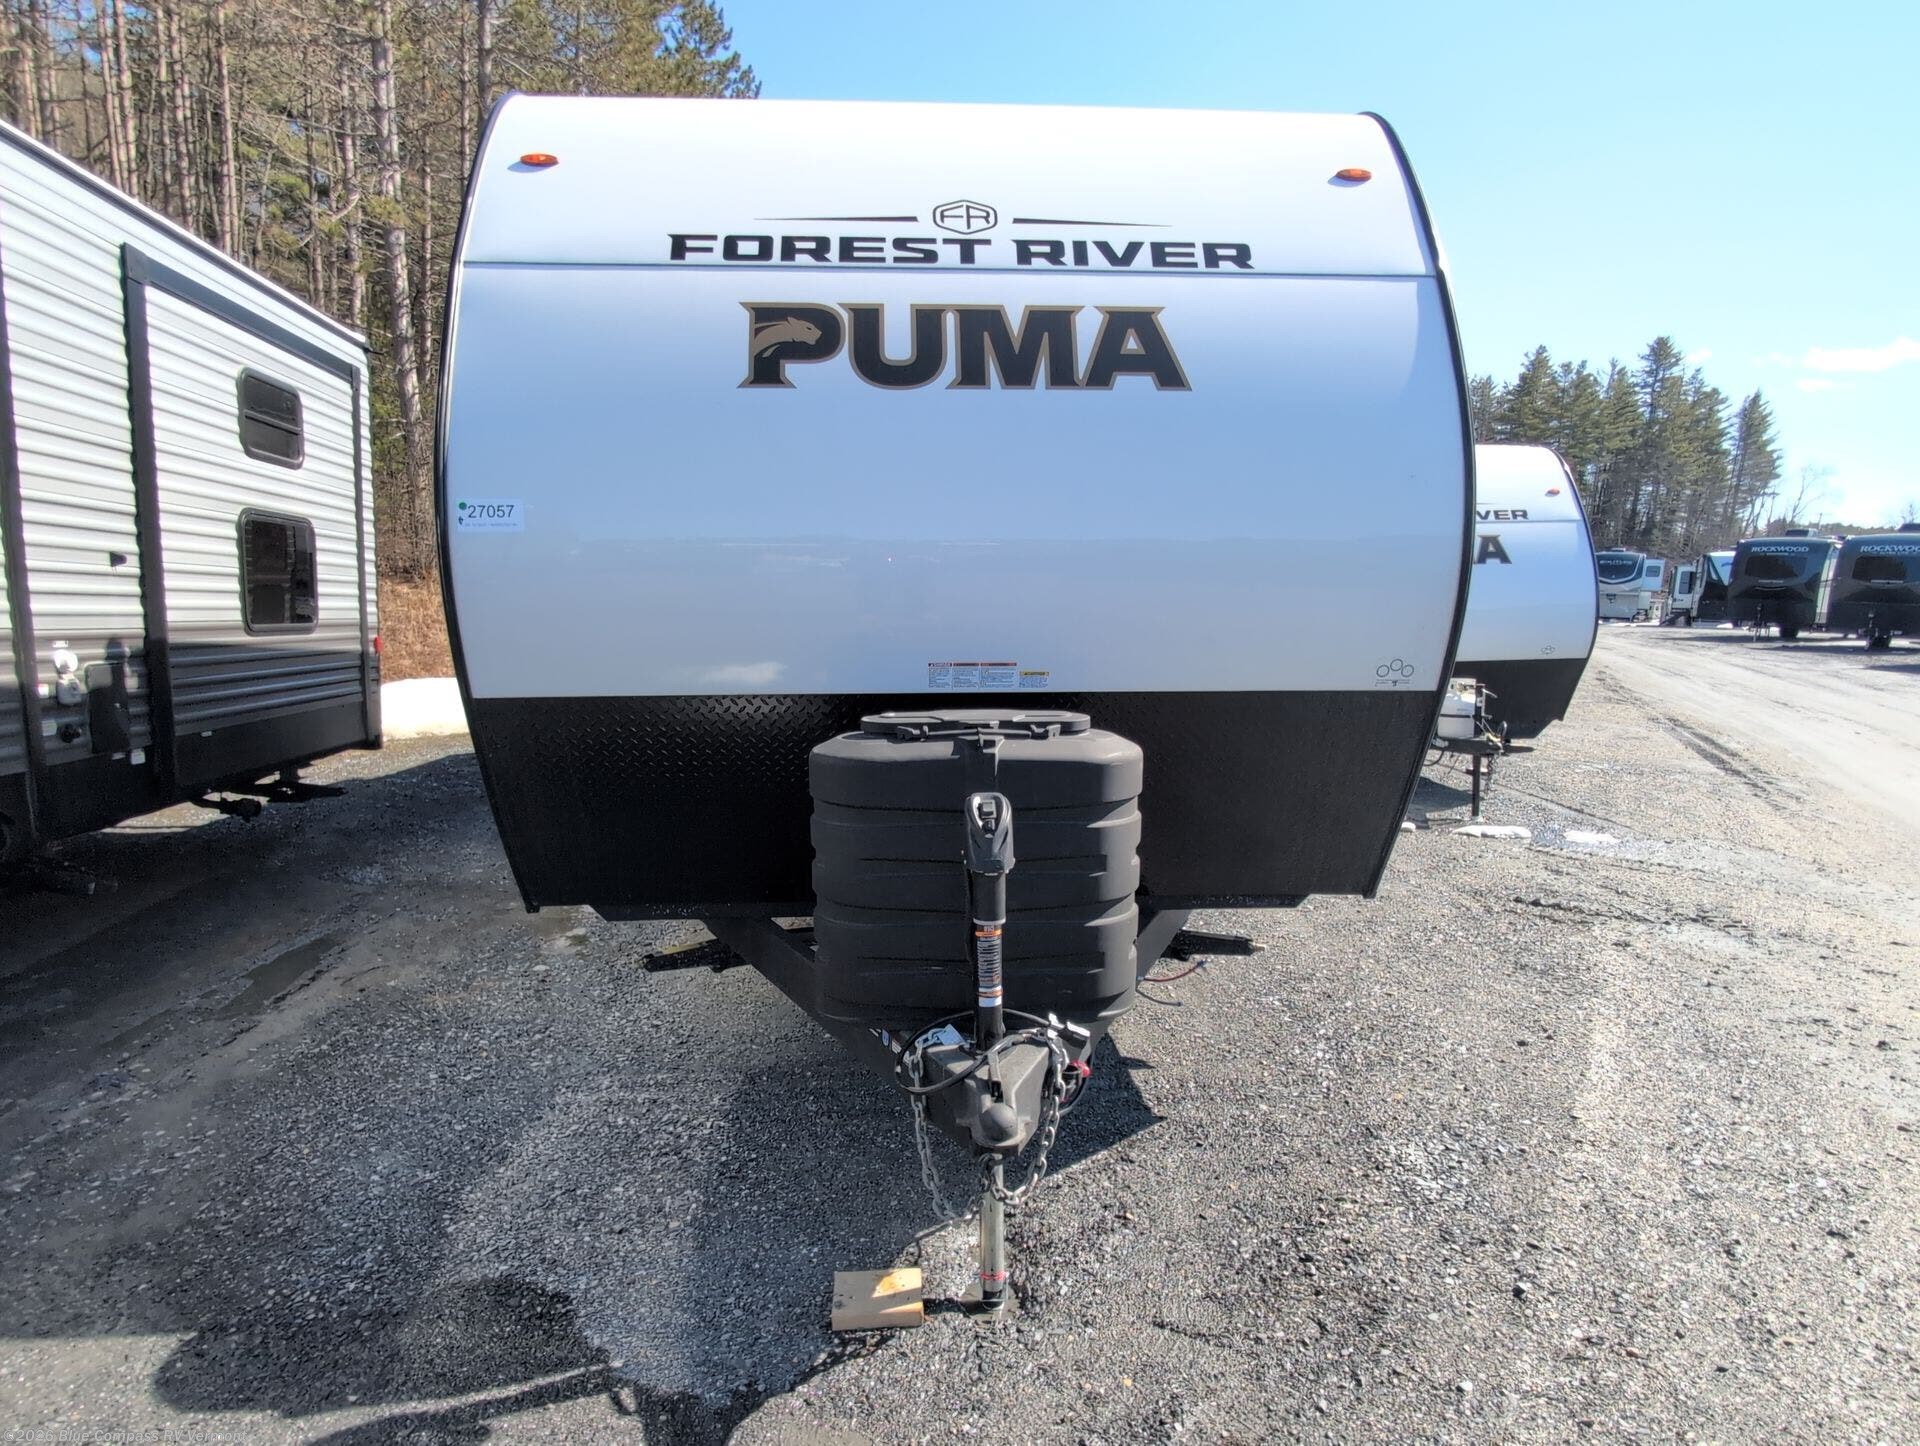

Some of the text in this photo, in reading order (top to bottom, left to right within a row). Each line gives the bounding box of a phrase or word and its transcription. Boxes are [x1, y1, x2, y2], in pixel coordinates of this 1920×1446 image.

[940, 204, 990, 230] FR
[667, 233, 1255, 270] FOREST RIVER
[737, 301, 1193, 391] PUMA
[467, 504, 515, 519] 27057
[1751, 545, 1809, 553] ROCKWOOD
